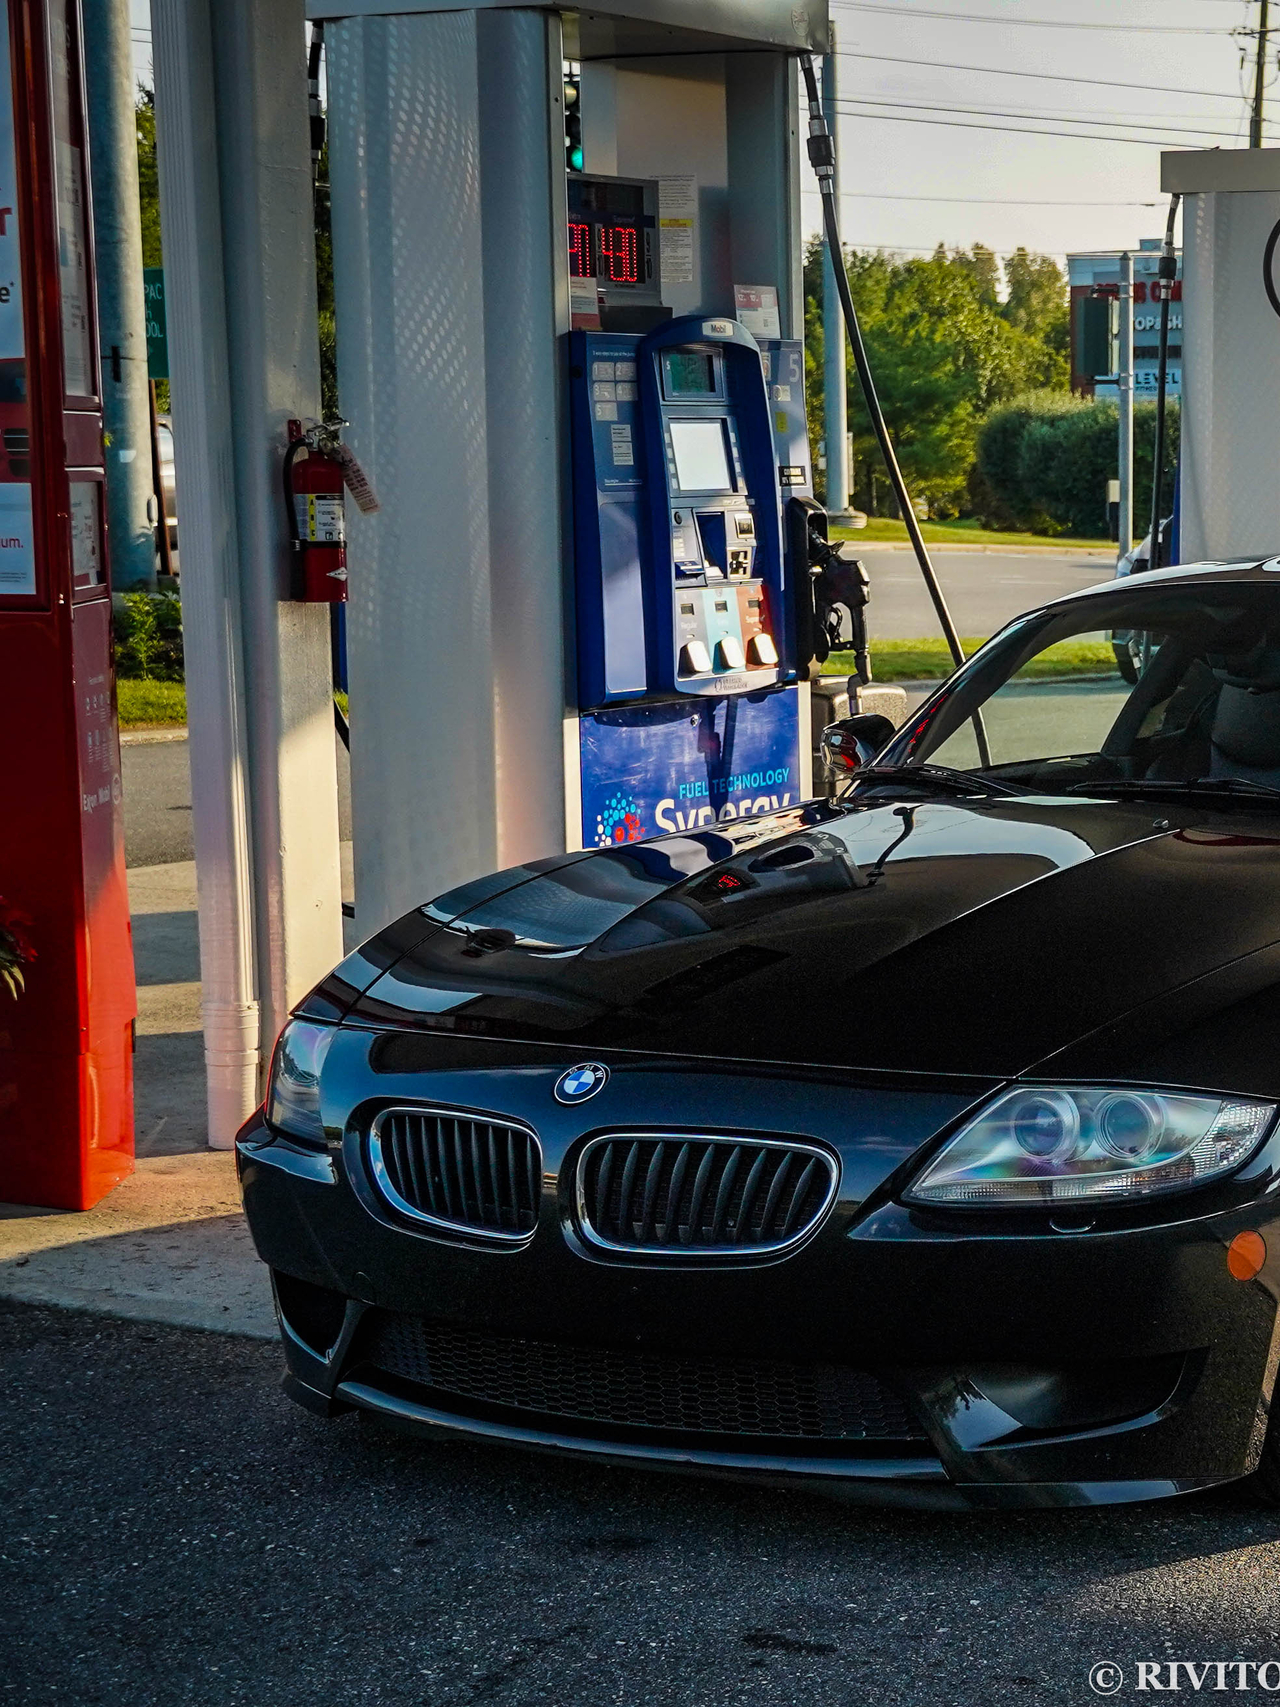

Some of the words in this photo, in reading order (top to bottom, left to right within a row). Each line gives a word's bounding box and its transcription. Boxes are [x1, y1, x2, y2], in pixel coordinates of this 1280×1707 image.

[711, 324, 727, 334] Mobil
[788, 353, 800, 383] 5
[679, 782, 709, 800] FUEL
[712, 767, 791, 794] TECHNOLOGY
[569, 1064, 604, 1079] BMW
